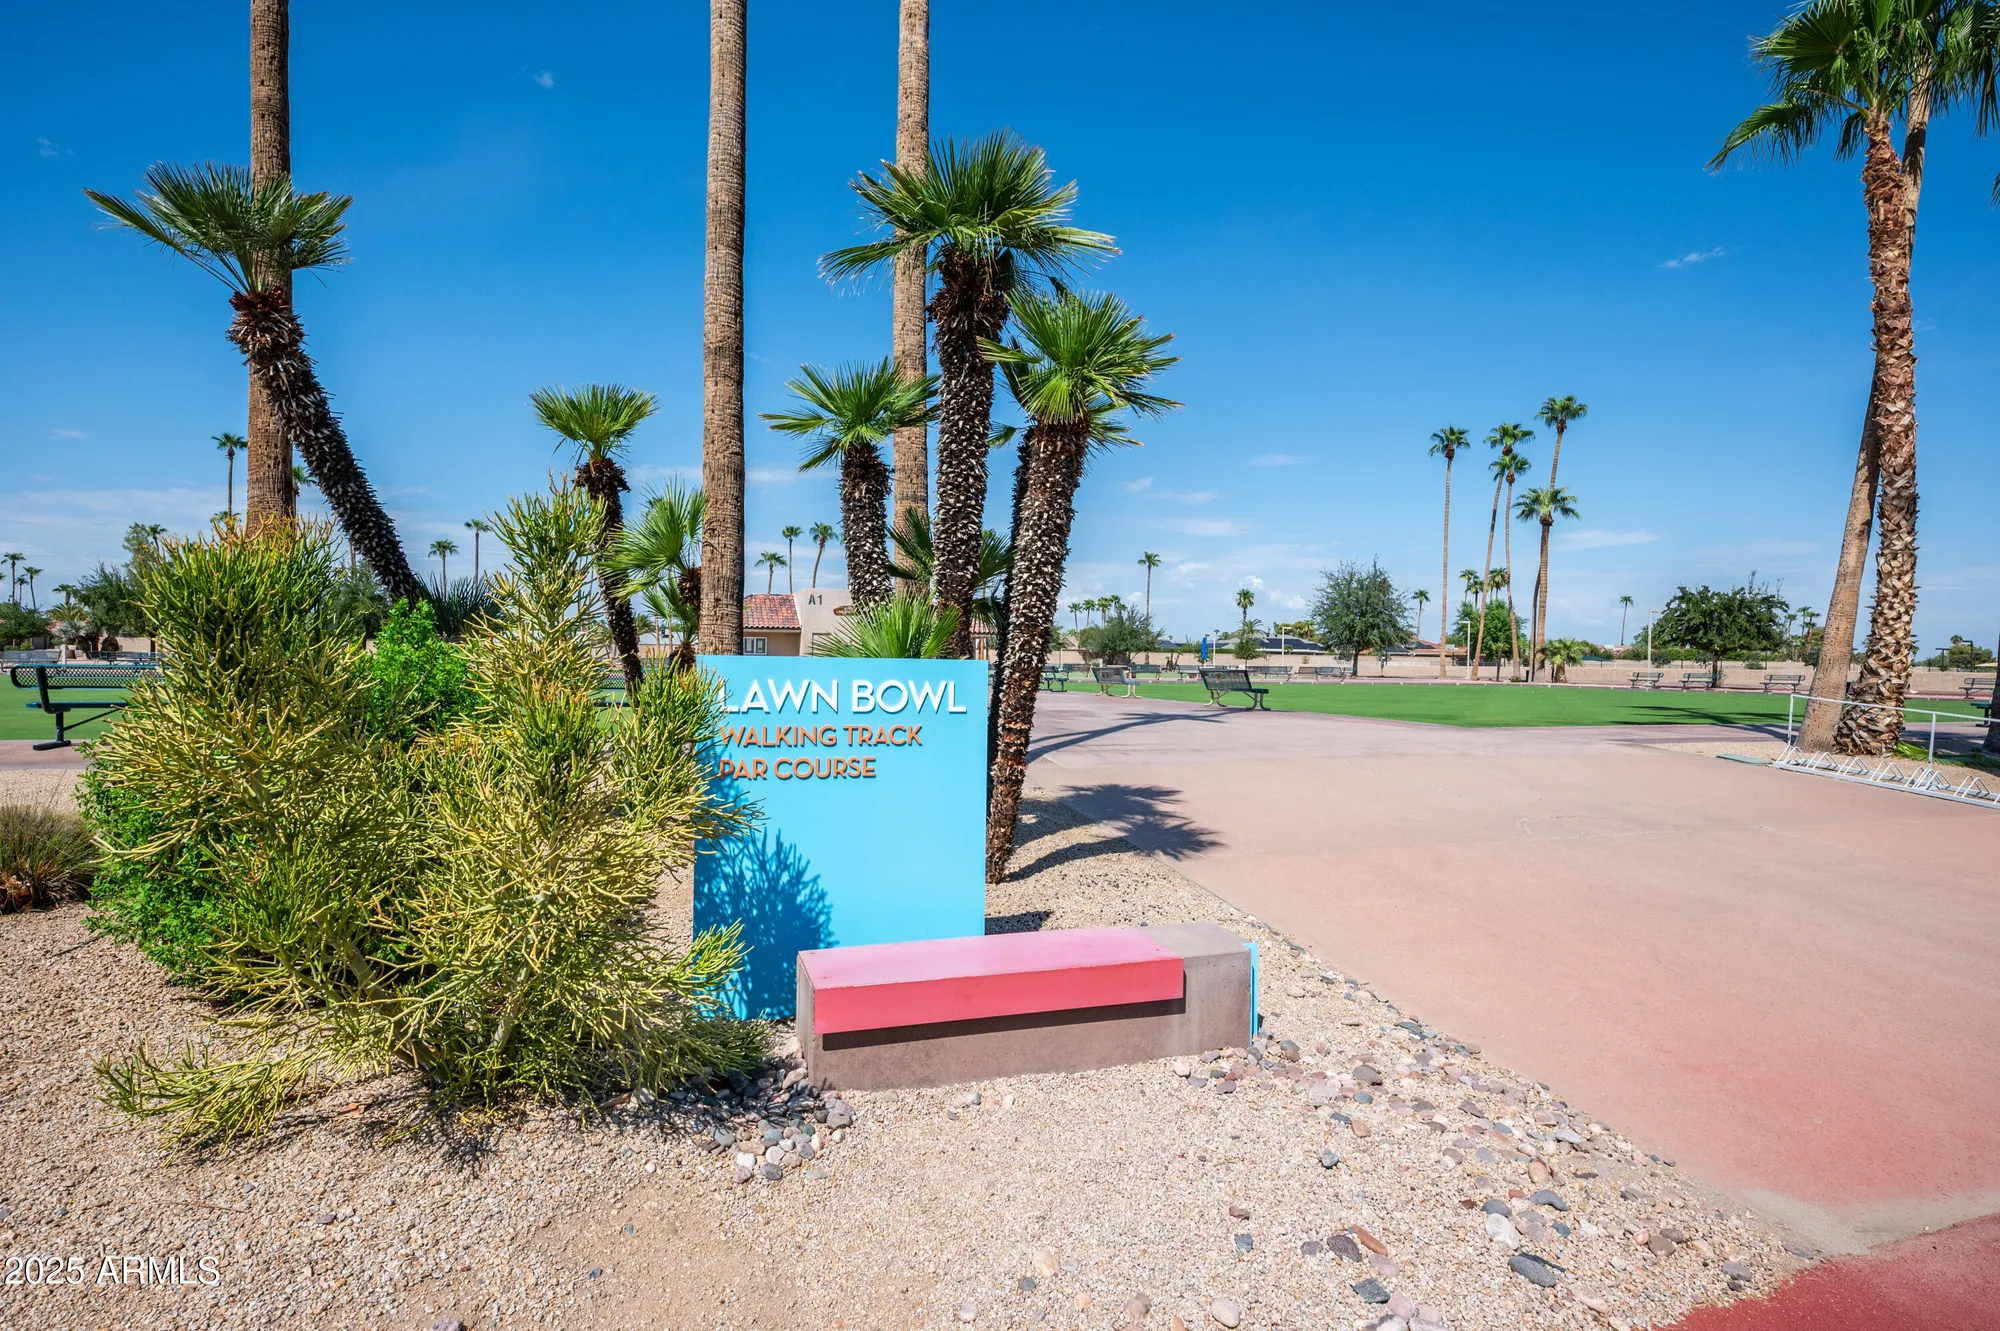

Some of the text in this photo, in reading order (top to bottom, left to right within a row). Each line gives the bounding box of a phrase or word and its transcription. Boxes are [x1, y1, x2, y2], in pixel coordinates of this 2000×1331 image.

[808, 594, 823, 605] A1
[720, 679, 967, 713] LAWN BOWL
[719, 725, 923, 747] WALKING TRACK
[719, 757, 876, 779] PAR COURSE
